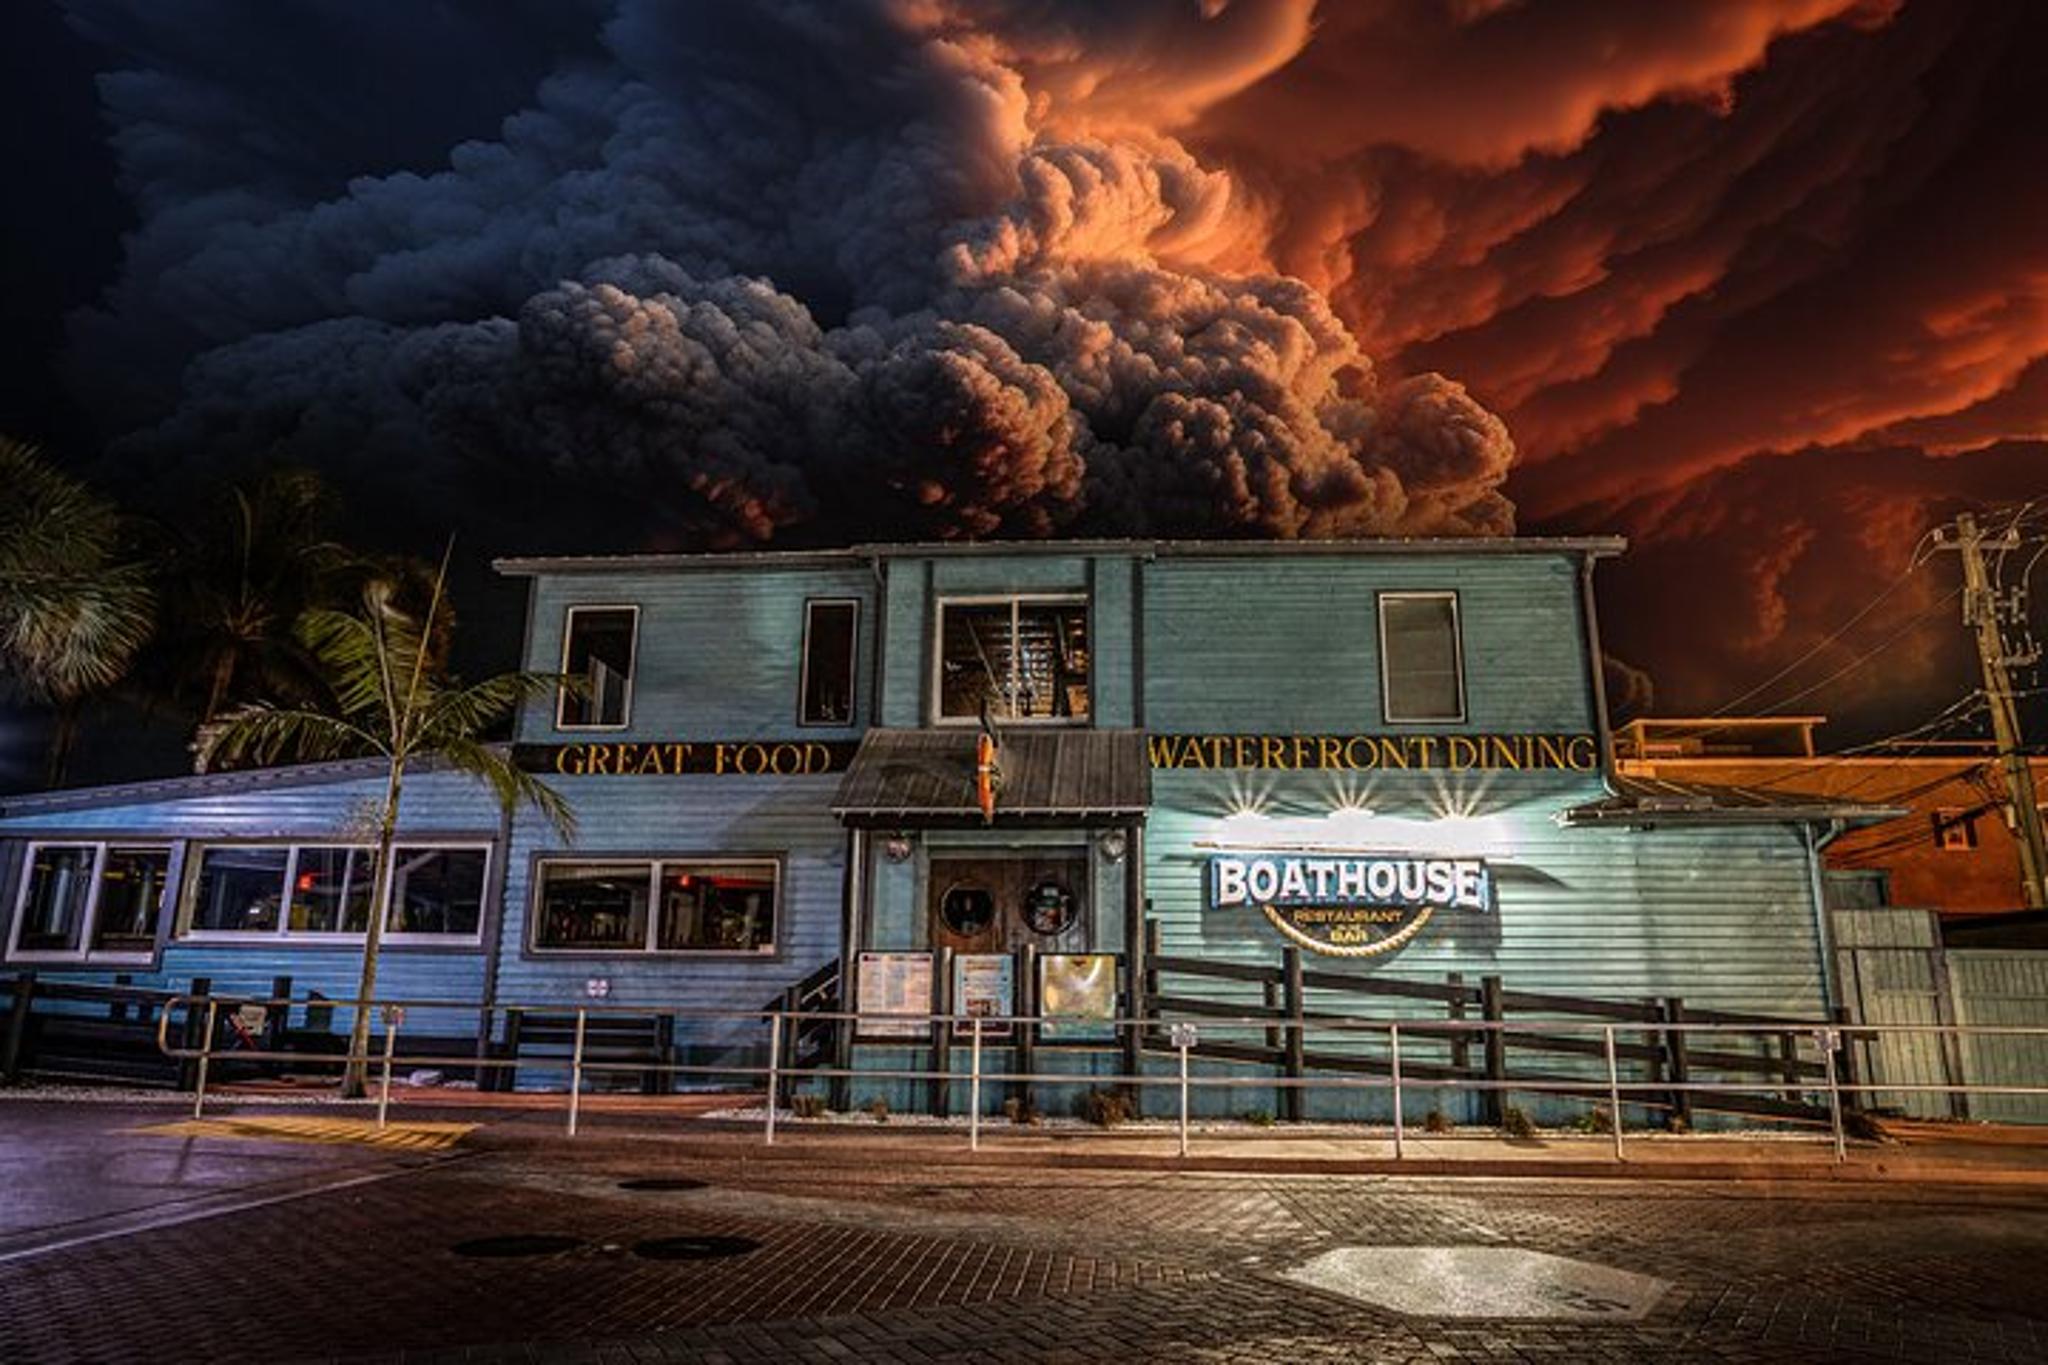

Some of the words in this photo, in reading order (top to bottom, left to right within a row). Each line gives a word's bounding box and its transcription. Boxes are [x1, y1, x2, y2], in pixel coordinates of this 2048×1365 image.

[557, 744, 691, 775] GREAT
[715, 743, 829, 775] FOOD
[1148, 735, 1436, 769] WATERFRONT
[1447, 734, 1597, 769] DINING
[1217, 858, 1482, 909] BOATHOUSE
[1293, 910, 1403, 923] RESTAURANT
[1330, 930, 1369, 943] BAR
